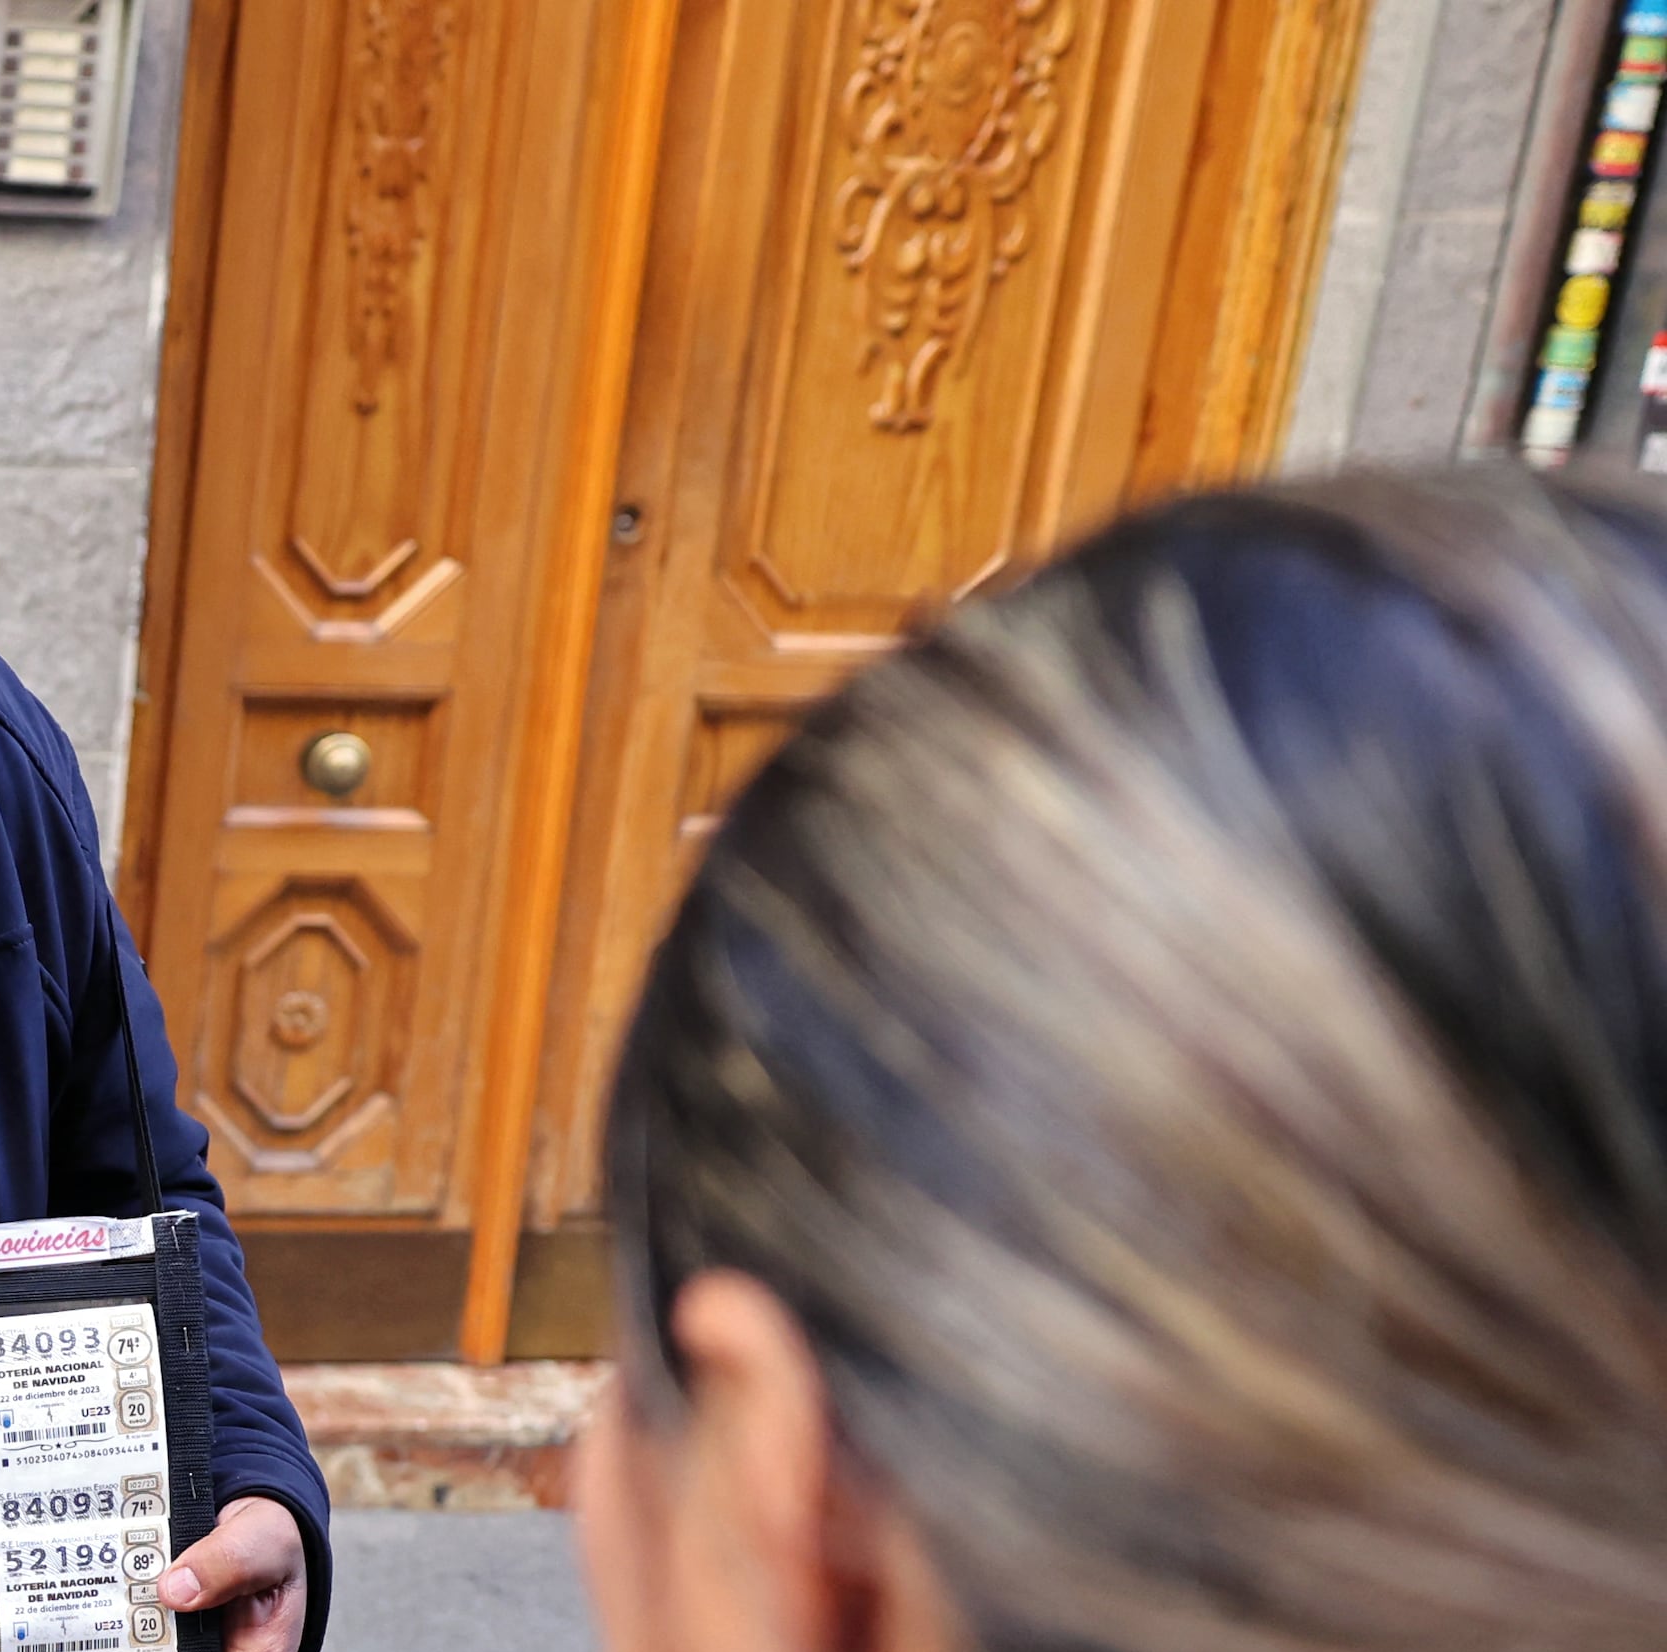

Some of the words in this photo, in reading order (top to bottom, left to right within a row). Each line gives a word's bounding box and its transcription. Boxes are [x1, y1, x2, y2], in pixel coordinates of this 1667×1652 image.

[44, 1360, 104, 1374] NACIONAL
[12, 1380, 27, 1389] DE
[31, 1374, 85, 1387] NAVIDAD
[12, 1393, 21, 1401] de
[24, 1388, 64, 1400] diciembre
[68, 1387, 77, 1395] de
[81, 1385, 99, 1393] 2023
[3, 1490, 116, 1521] 84093
[6, 1543, 117, 1572] 52196
[7, 1578, 56, 1591] LOTERÍA
[60, 1575, 118, 1587] NACIONAL
[28, 1593, 43, 1601] DE
[47, 1588, 99, 1600] NAVIDAD
